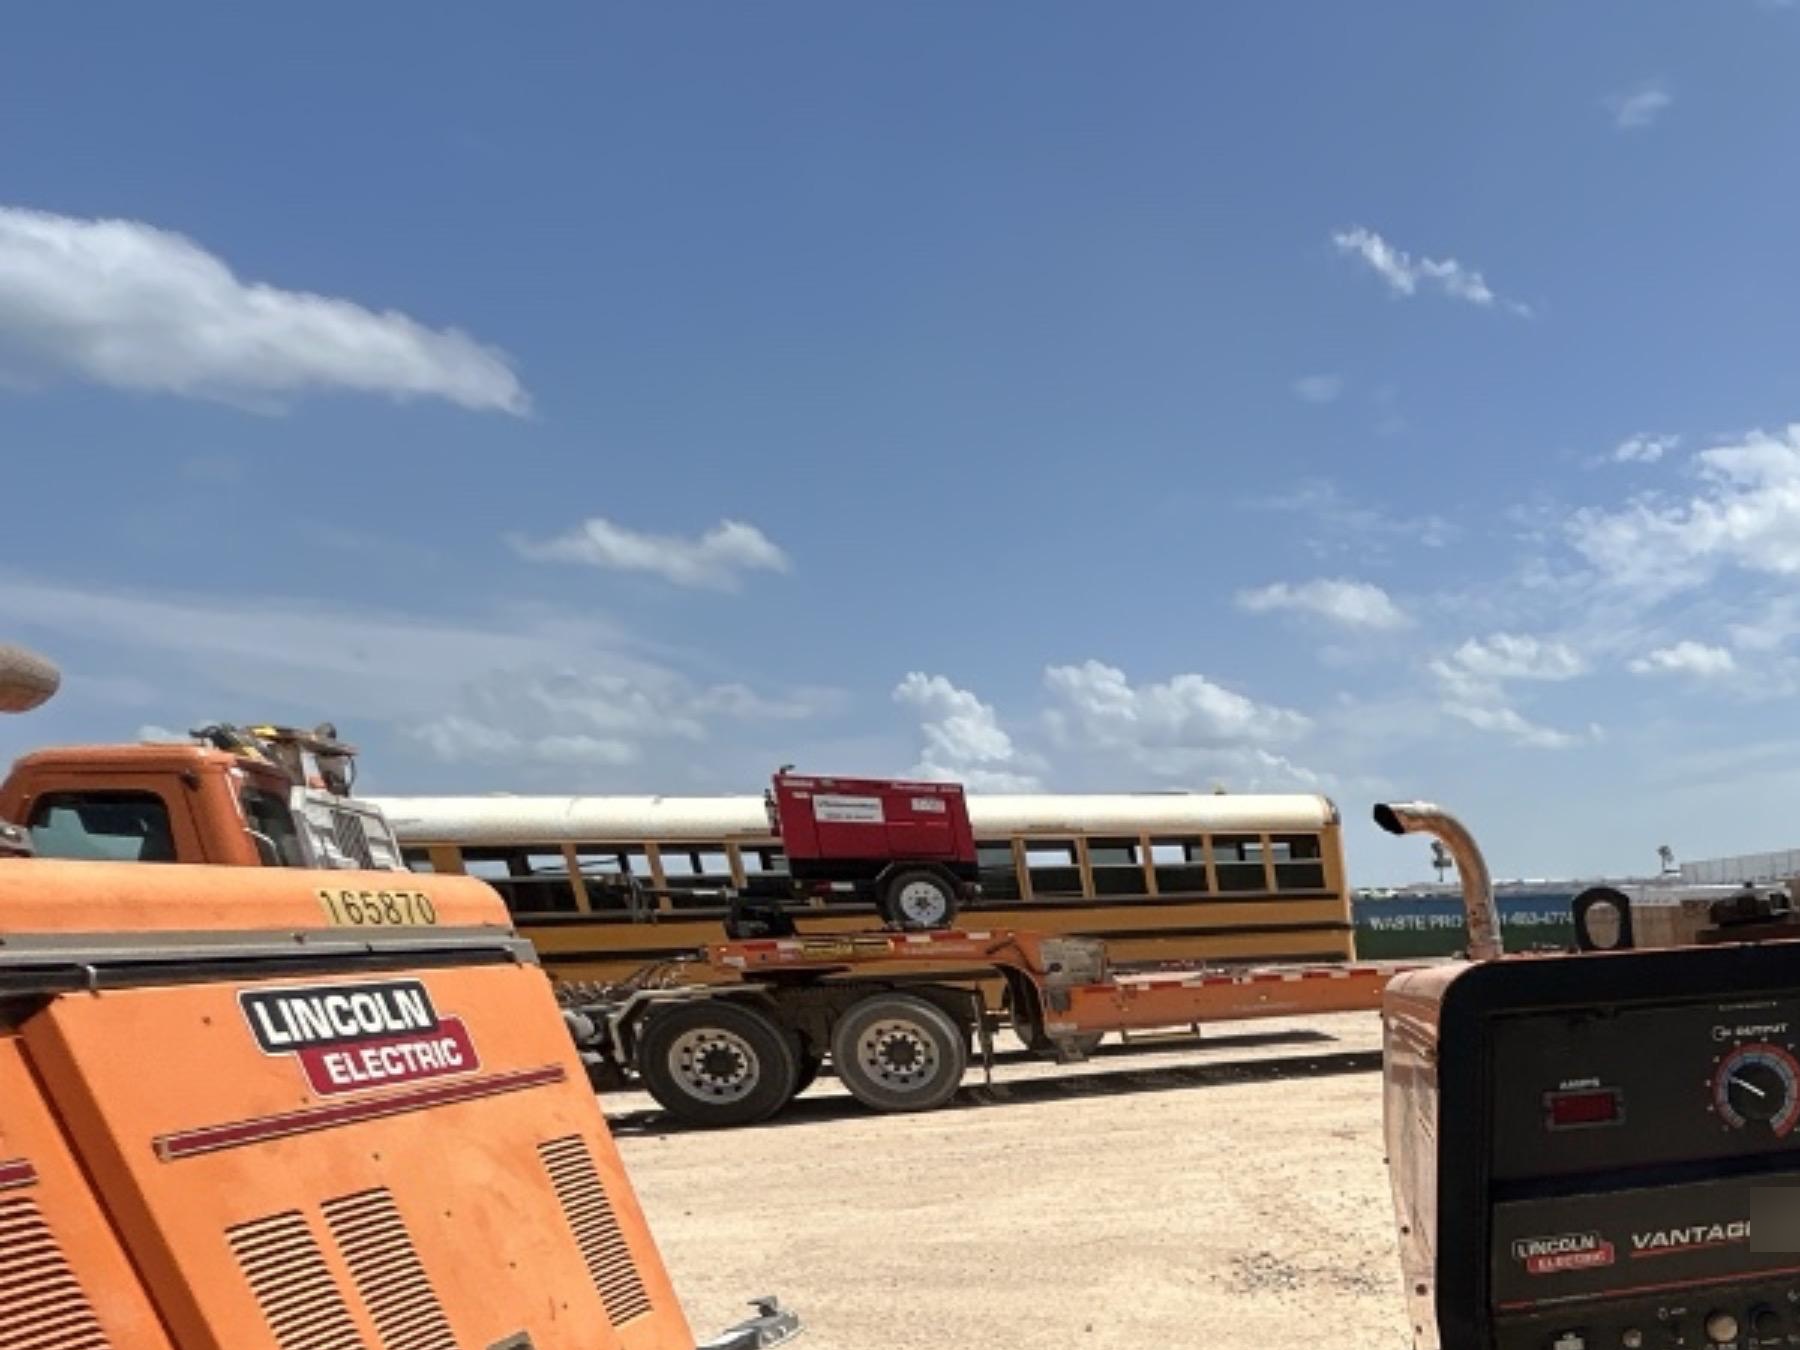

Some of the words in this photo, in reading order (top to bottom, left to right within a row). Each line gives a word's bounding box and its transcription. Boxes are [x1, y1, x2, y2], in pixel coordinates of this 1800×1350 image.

[319, 890, 437, 925] 165870
[1369, 914, 1426, 931] WASTE
[1428, 914, 1464, 930] PRO
[253, 989, 433, 1046] LINCOLN
[322, 1037, 464, 1085] ELECTRIC
[1516, 1234, 1596, 1259] LINCOLN
[1631, 1220, 1751, 1250] VANTAG
